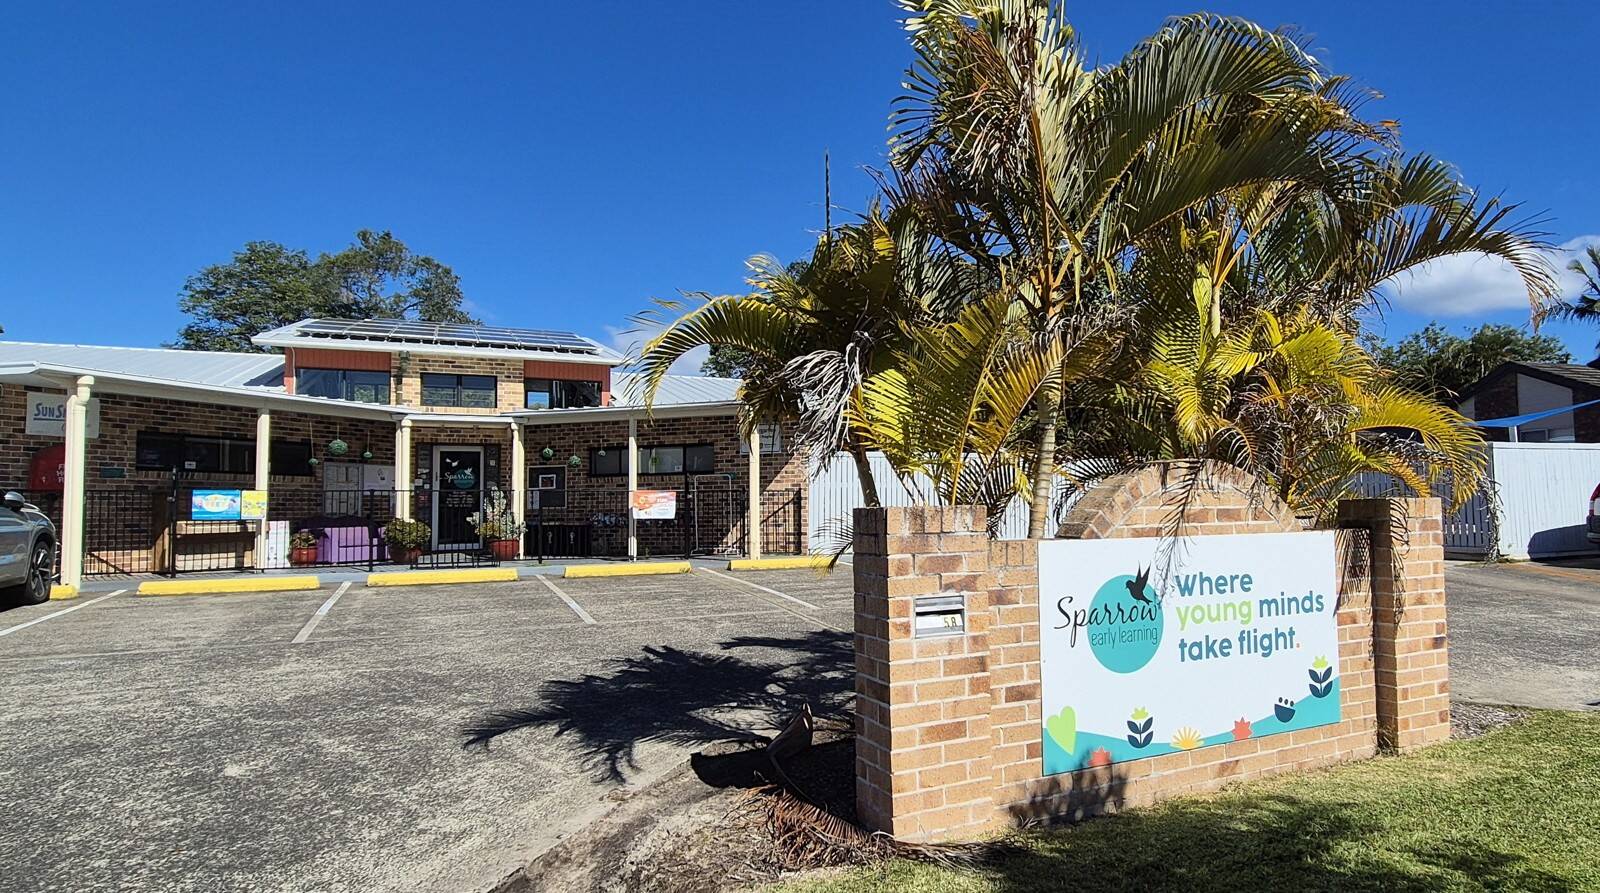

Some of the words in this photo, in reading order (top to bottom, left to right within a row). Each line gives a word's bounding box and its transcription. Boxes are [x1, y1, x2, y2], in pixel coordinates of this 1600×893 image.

[1175, 571, 1253, 598] Where
[1053, 595, 1158, 648] Sparrow
[1175, 599, 1252, 632] young
[1258, 590, 1325, 618] minds
[1091, 627, 1117, 649] early
[1118, 624, 1158, 646] learning
[1178, 634, 1233, 663] take
[1237, 625, 1301, 658] flight.
